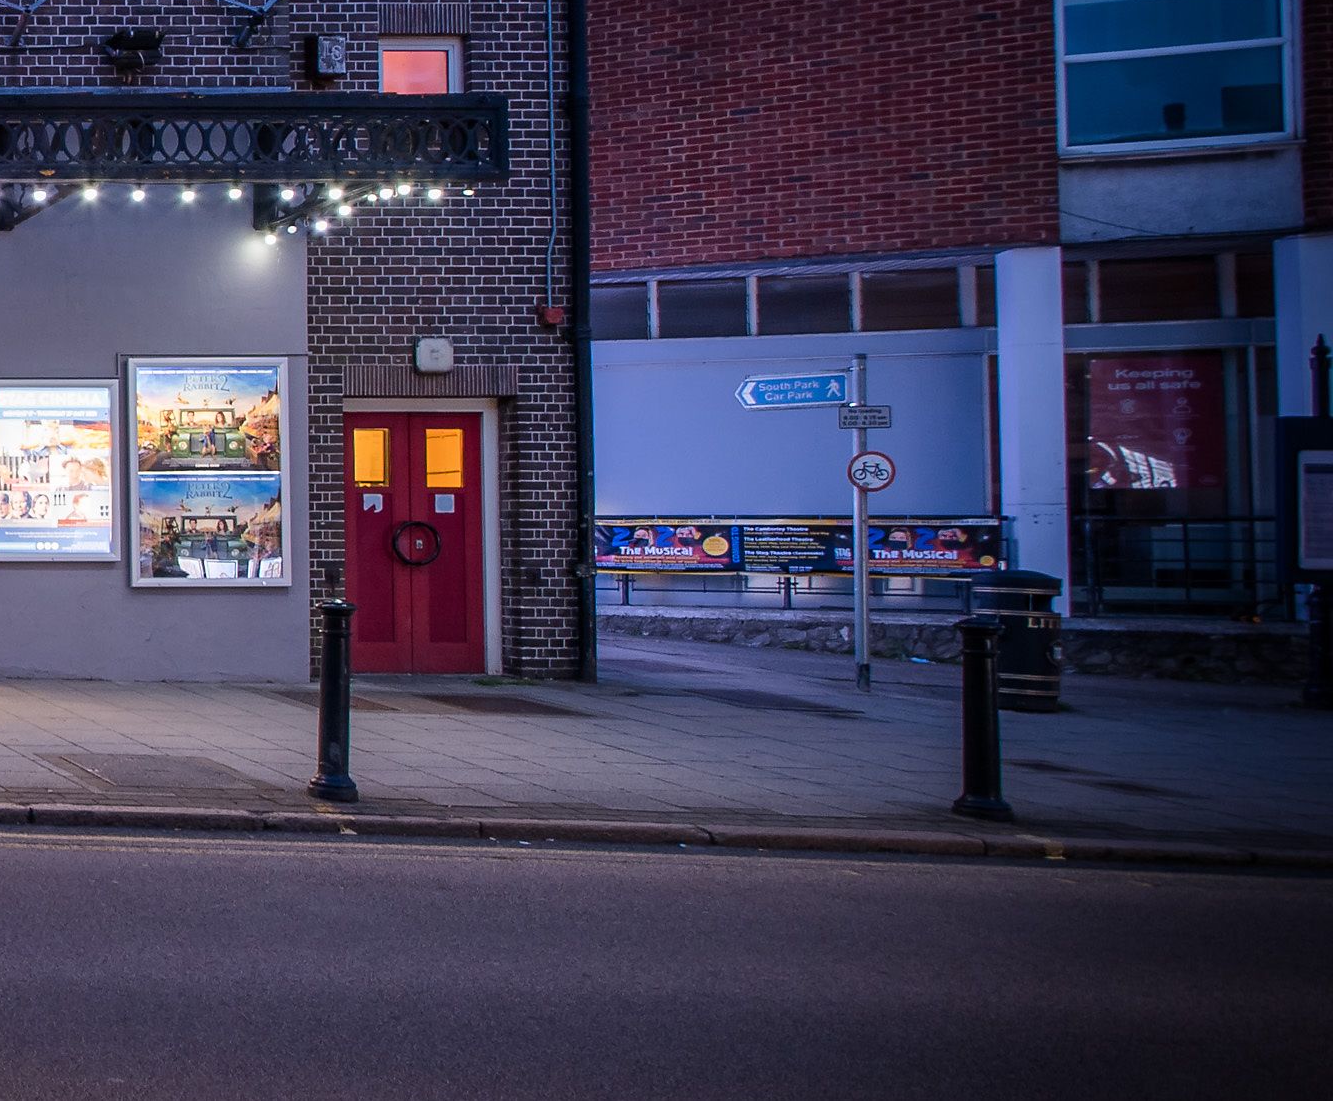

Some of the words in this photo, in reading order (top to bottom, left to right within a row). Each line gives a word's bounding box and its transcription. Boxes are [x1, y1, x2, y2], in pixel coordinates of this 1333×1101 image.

[1114, 369, 1194, 380] Keeping
[758, 382, 791, 391] South
[794, 380, 819, 389] Park
[1135, 380, 1155, 390] all
[1159, 380, 1201, 390] safe
[764, 392, 783, 401] Car
[787, 392, 812, 400] Park
[186, 490, 223, 499] RABBIT
[223, 481, 233, 499] 2
[619, 547, 641, 555] The
[644, 546, 693, 556] Musical
[873, 549, 899, 559] The
[902, 549, 958, 559] Musical
